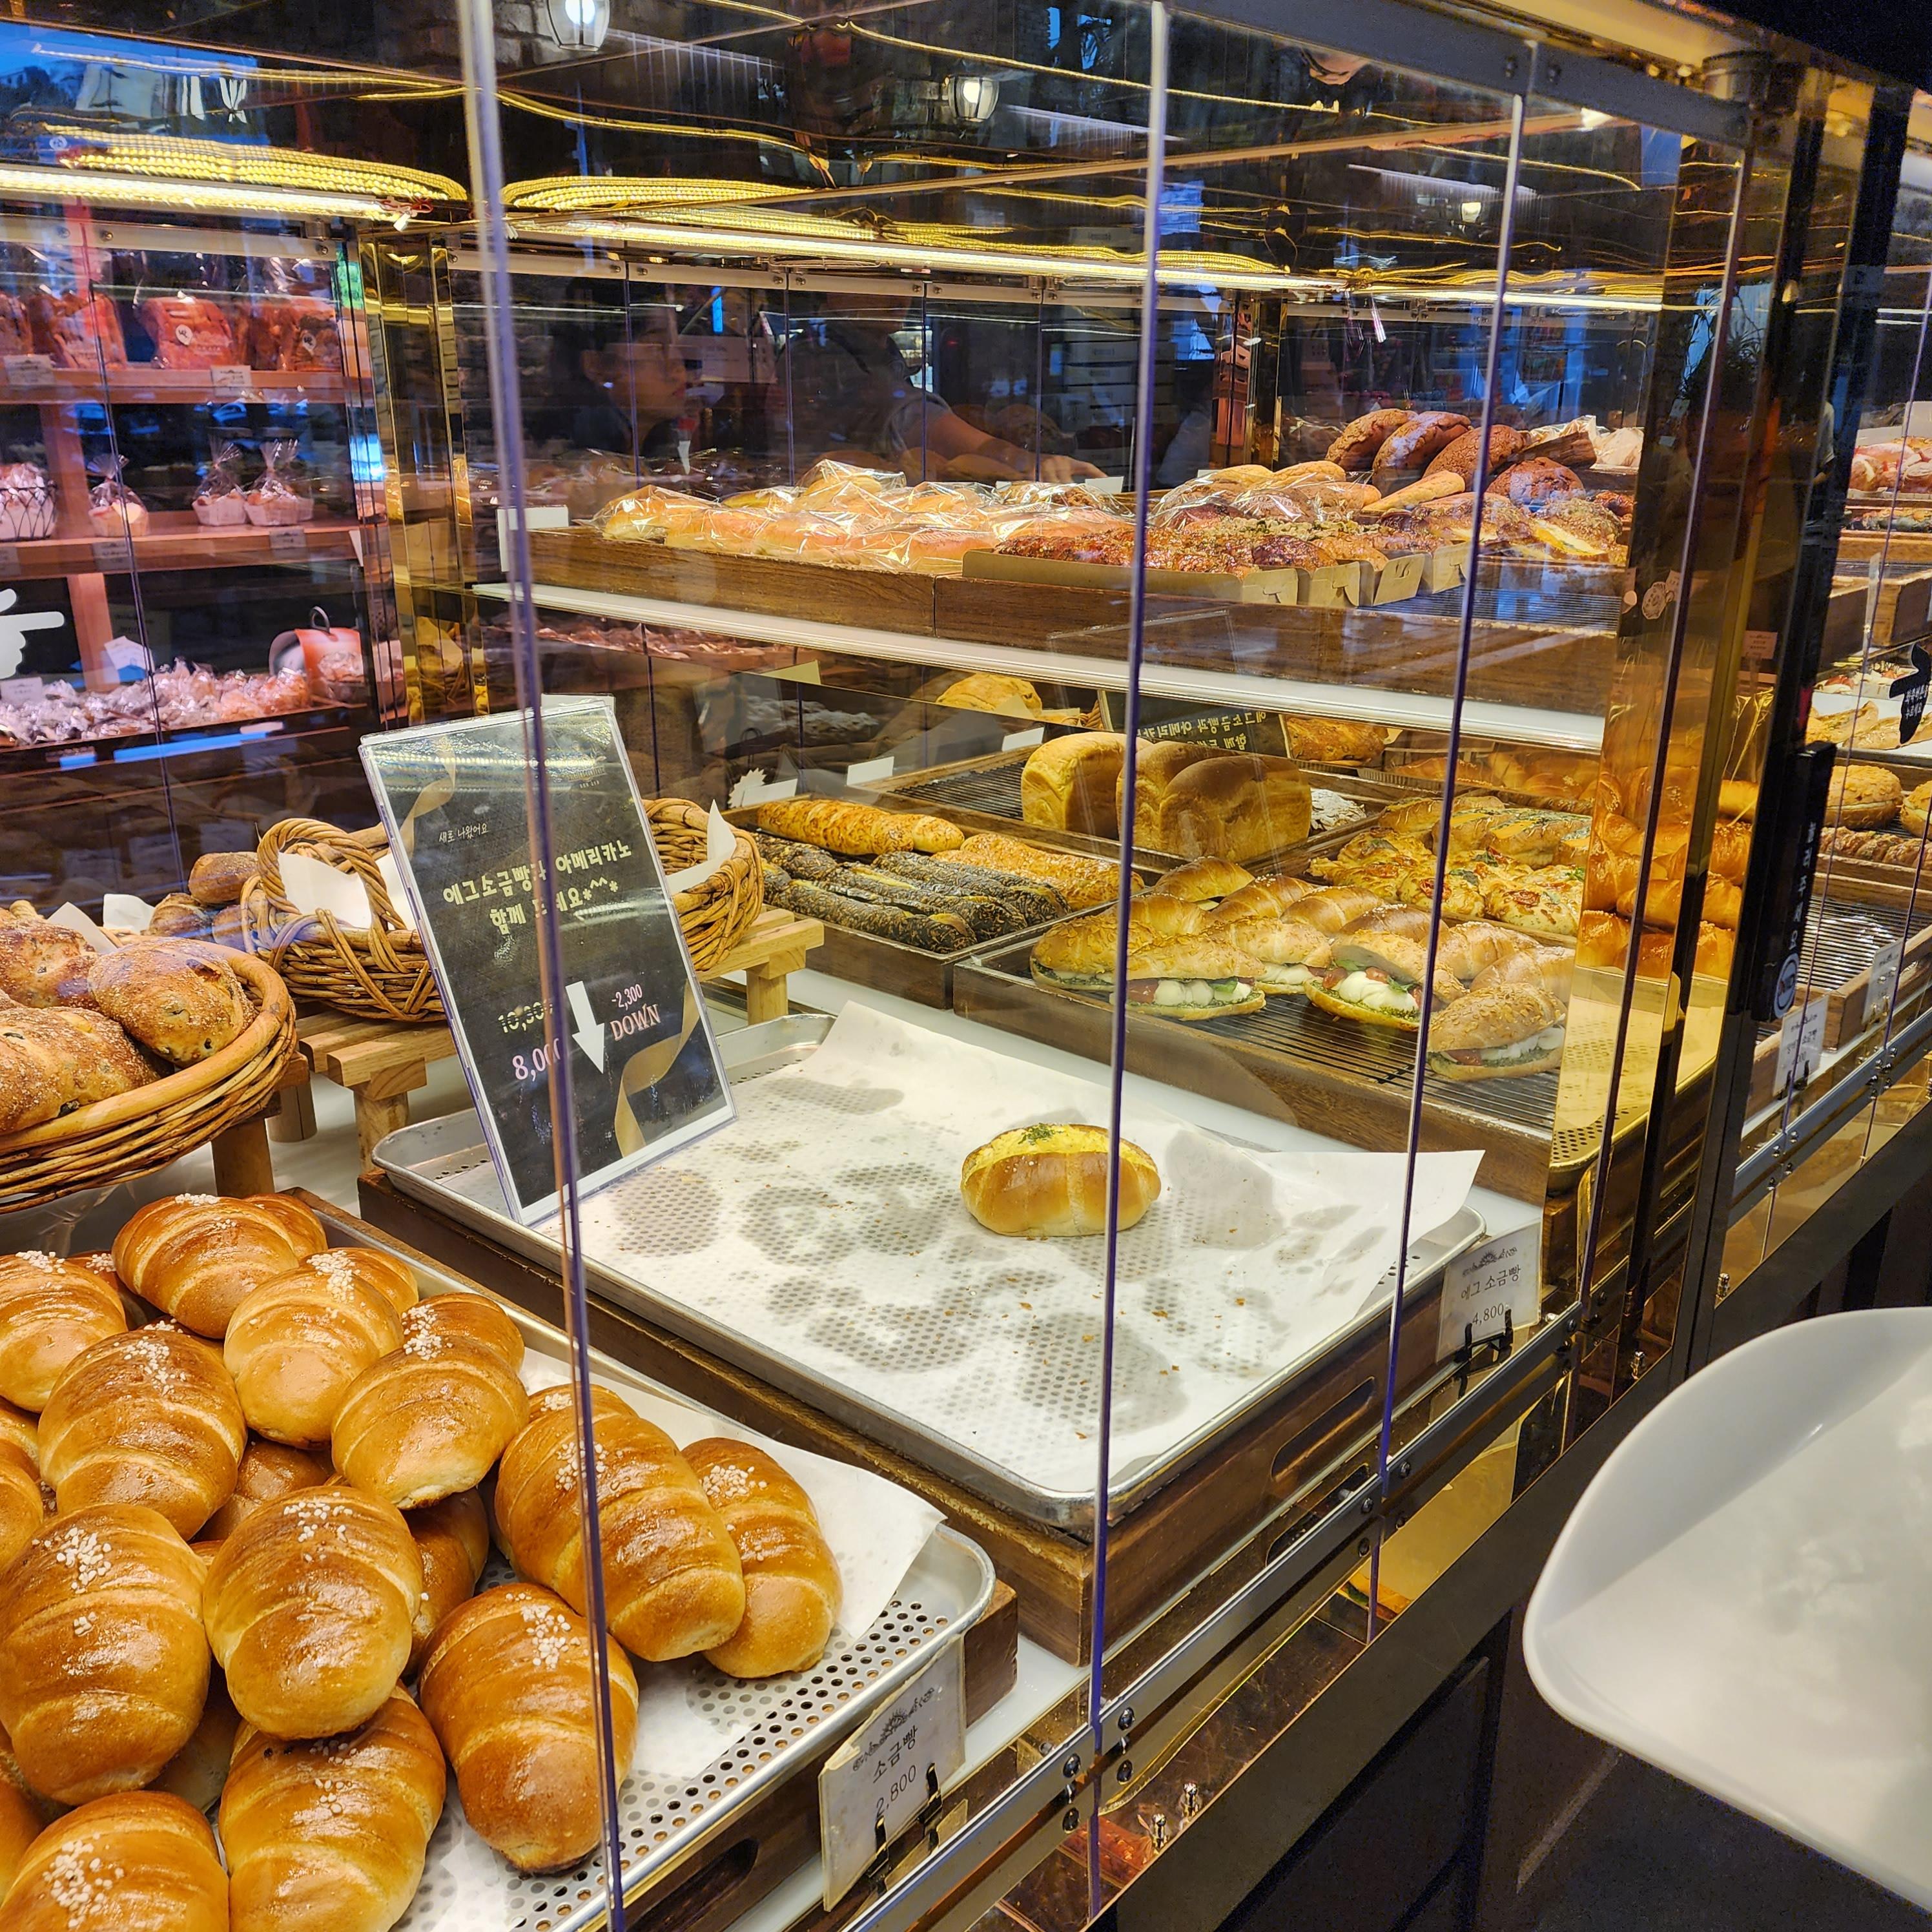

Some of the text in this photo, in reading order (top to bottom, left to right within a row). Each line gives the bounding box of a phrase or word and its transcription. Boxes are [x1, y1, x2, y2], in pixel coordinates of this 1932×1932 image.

[438, 823, 489, 844] 새로 나왔어요
[442, 839, 632, 905] 에그소금빵과 아메리카노
[489, 903, 526, 935] 함께
[611, 983, 643, 1011] -2,300
[610, 1003, 662, 1042] DOWN
[1460, 1264, 1521, 1300] 에그 소금빵
[1472, 1302, 1505, 1326] 4,800
[872, 1725, 919, 1784] 소금빵
[875, 1764, 917, 1819] 2,800
